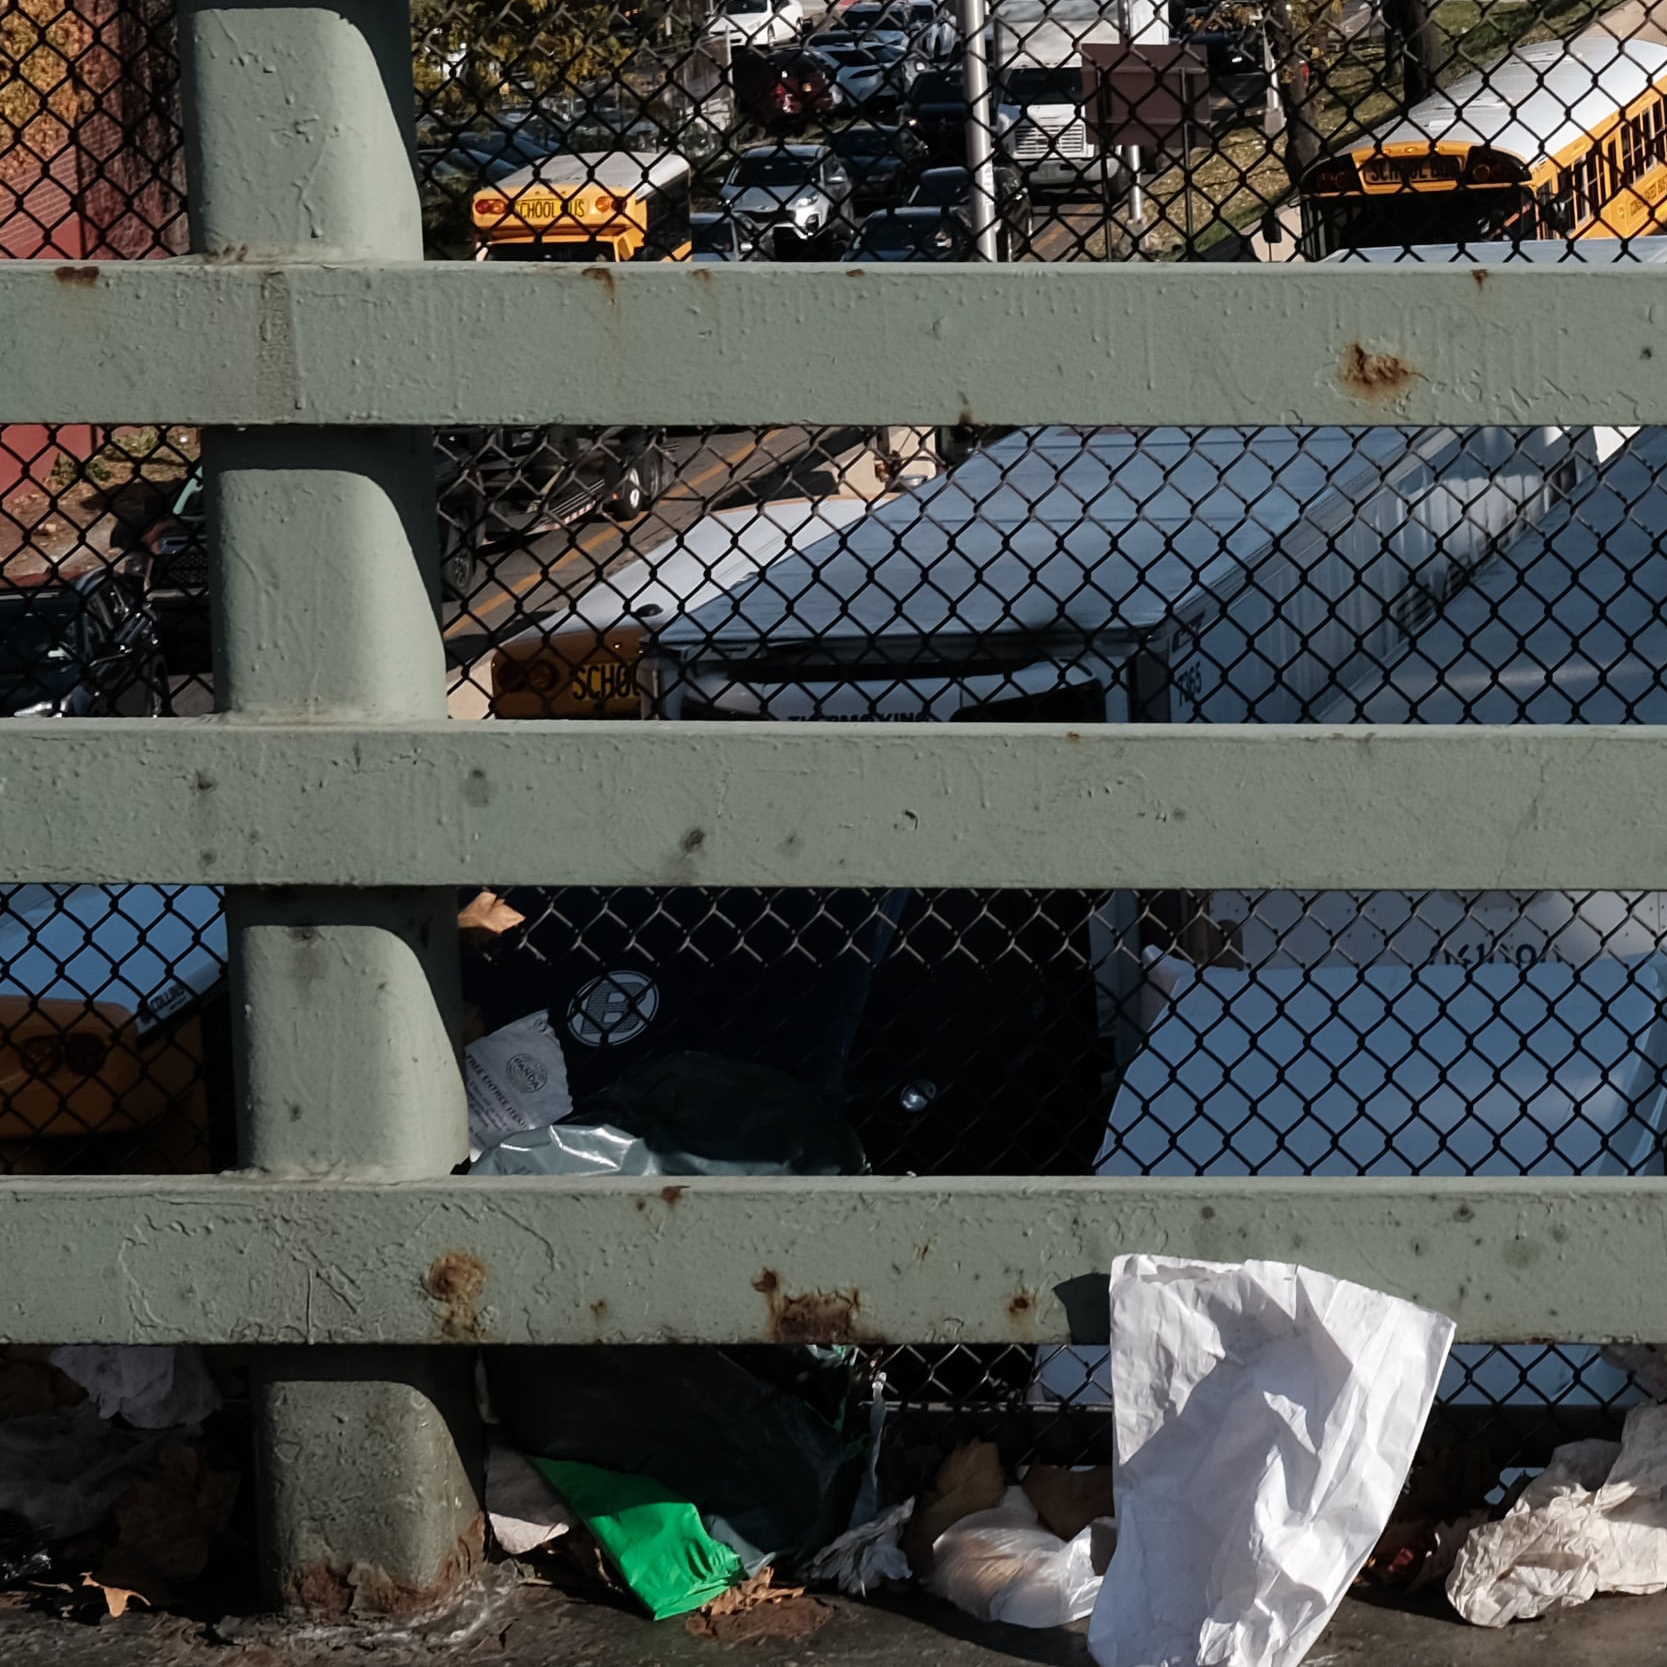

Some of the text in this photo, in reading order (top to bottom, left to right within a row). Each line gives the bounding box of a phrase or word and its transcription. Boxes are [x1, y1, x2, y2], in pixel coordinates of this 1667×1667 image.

[1370, 159, 1426, 182] SCHOL
[514, 199, 557, 219] CHOOL
[572, 665, 641, 701] SCHO
